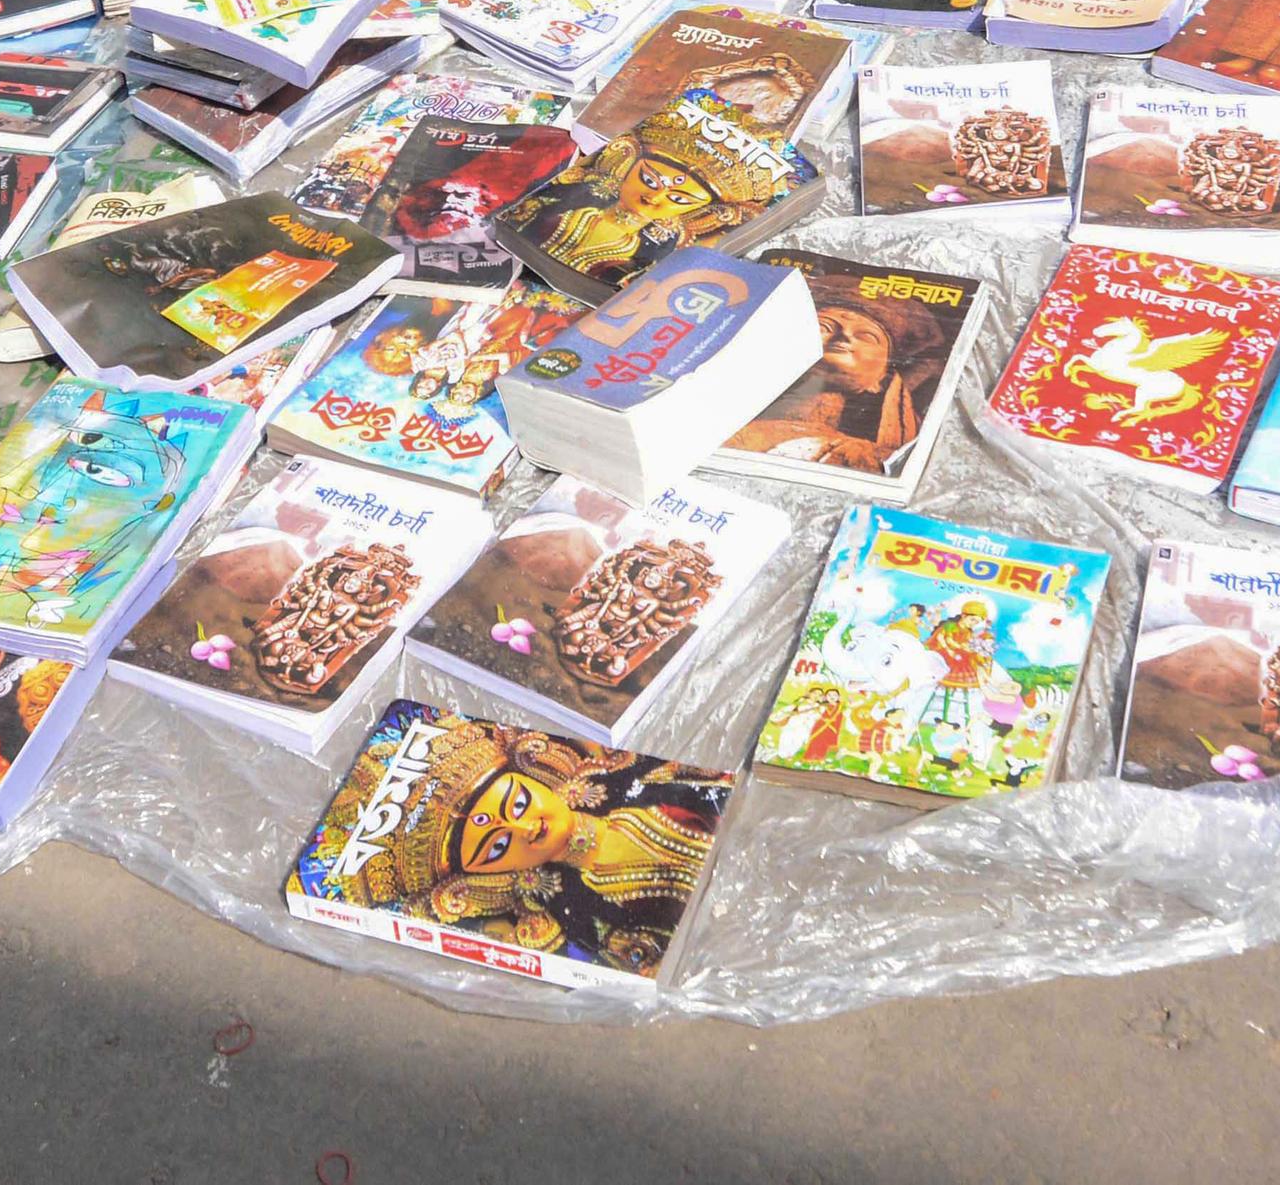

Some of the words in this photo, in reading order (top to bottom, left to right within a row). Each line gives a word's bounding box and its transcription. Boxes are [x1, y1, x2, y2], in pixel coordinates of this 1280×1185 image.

[676, 99, 795, 183] বর্তমান
[859, 274, 964, 308] কৃত্তিবাস
[1094, 274, 1252, 323] মায়াকানন
[315, 486, 384, 522] শারদীয়া
[389, 510, 434, 535] চর্যা
[885, 540, 1053, 594] শুকতারা
[944, 531, 1009, 557] শারদীয়া
[331, 719, 449, 878] বর্তমান
